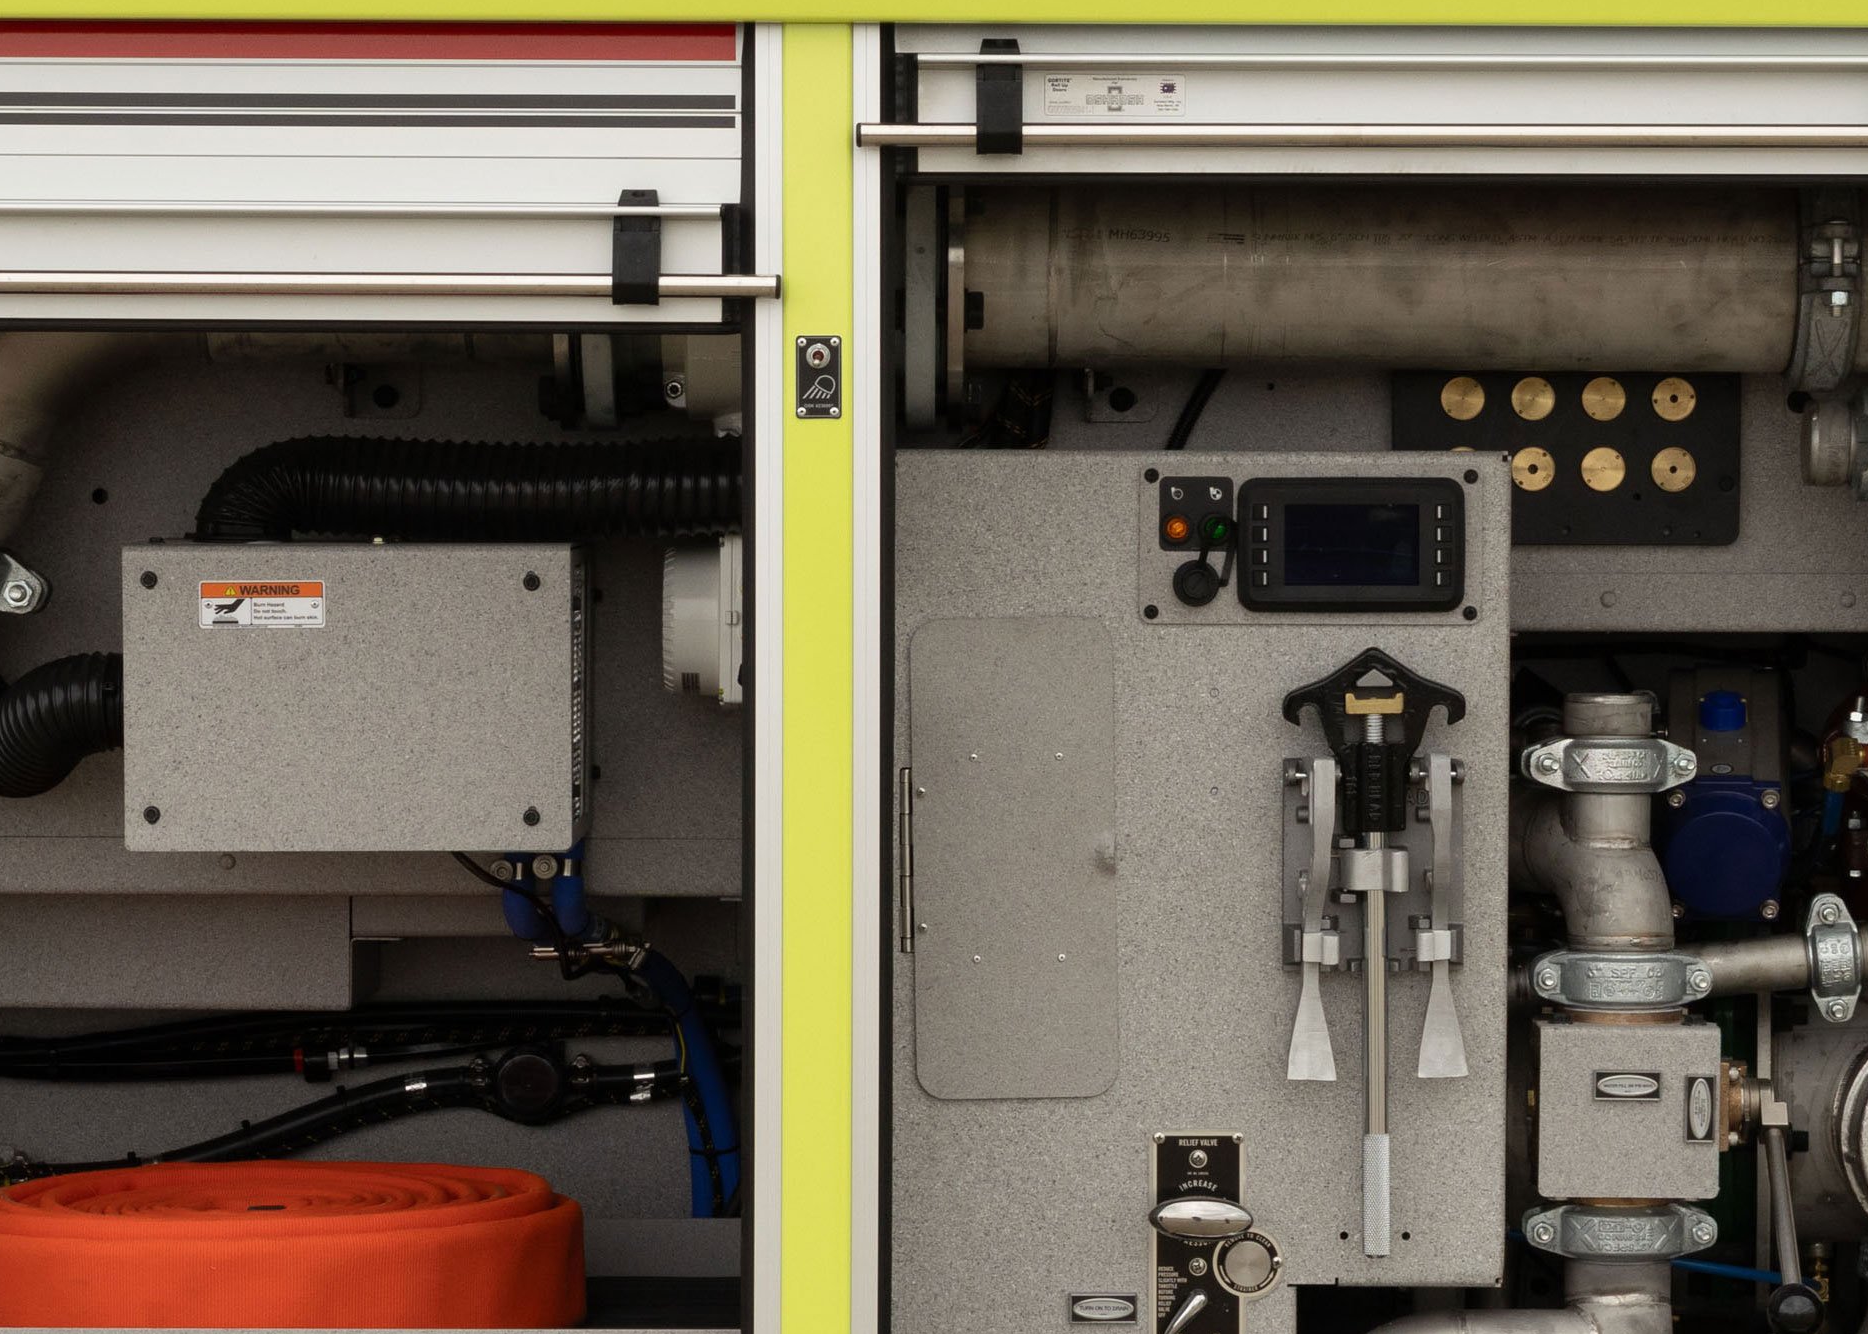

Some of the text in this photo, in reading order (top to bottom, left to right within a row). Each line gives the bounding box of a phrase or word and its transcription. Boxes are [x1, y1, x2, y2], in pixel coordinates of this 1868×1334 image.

[239, 585, 300, 595] WARNING
[1178, 1138, 1218, 1147] RELIEF VALVE
[1178, 1179, 1219, 1192] INCREASE
